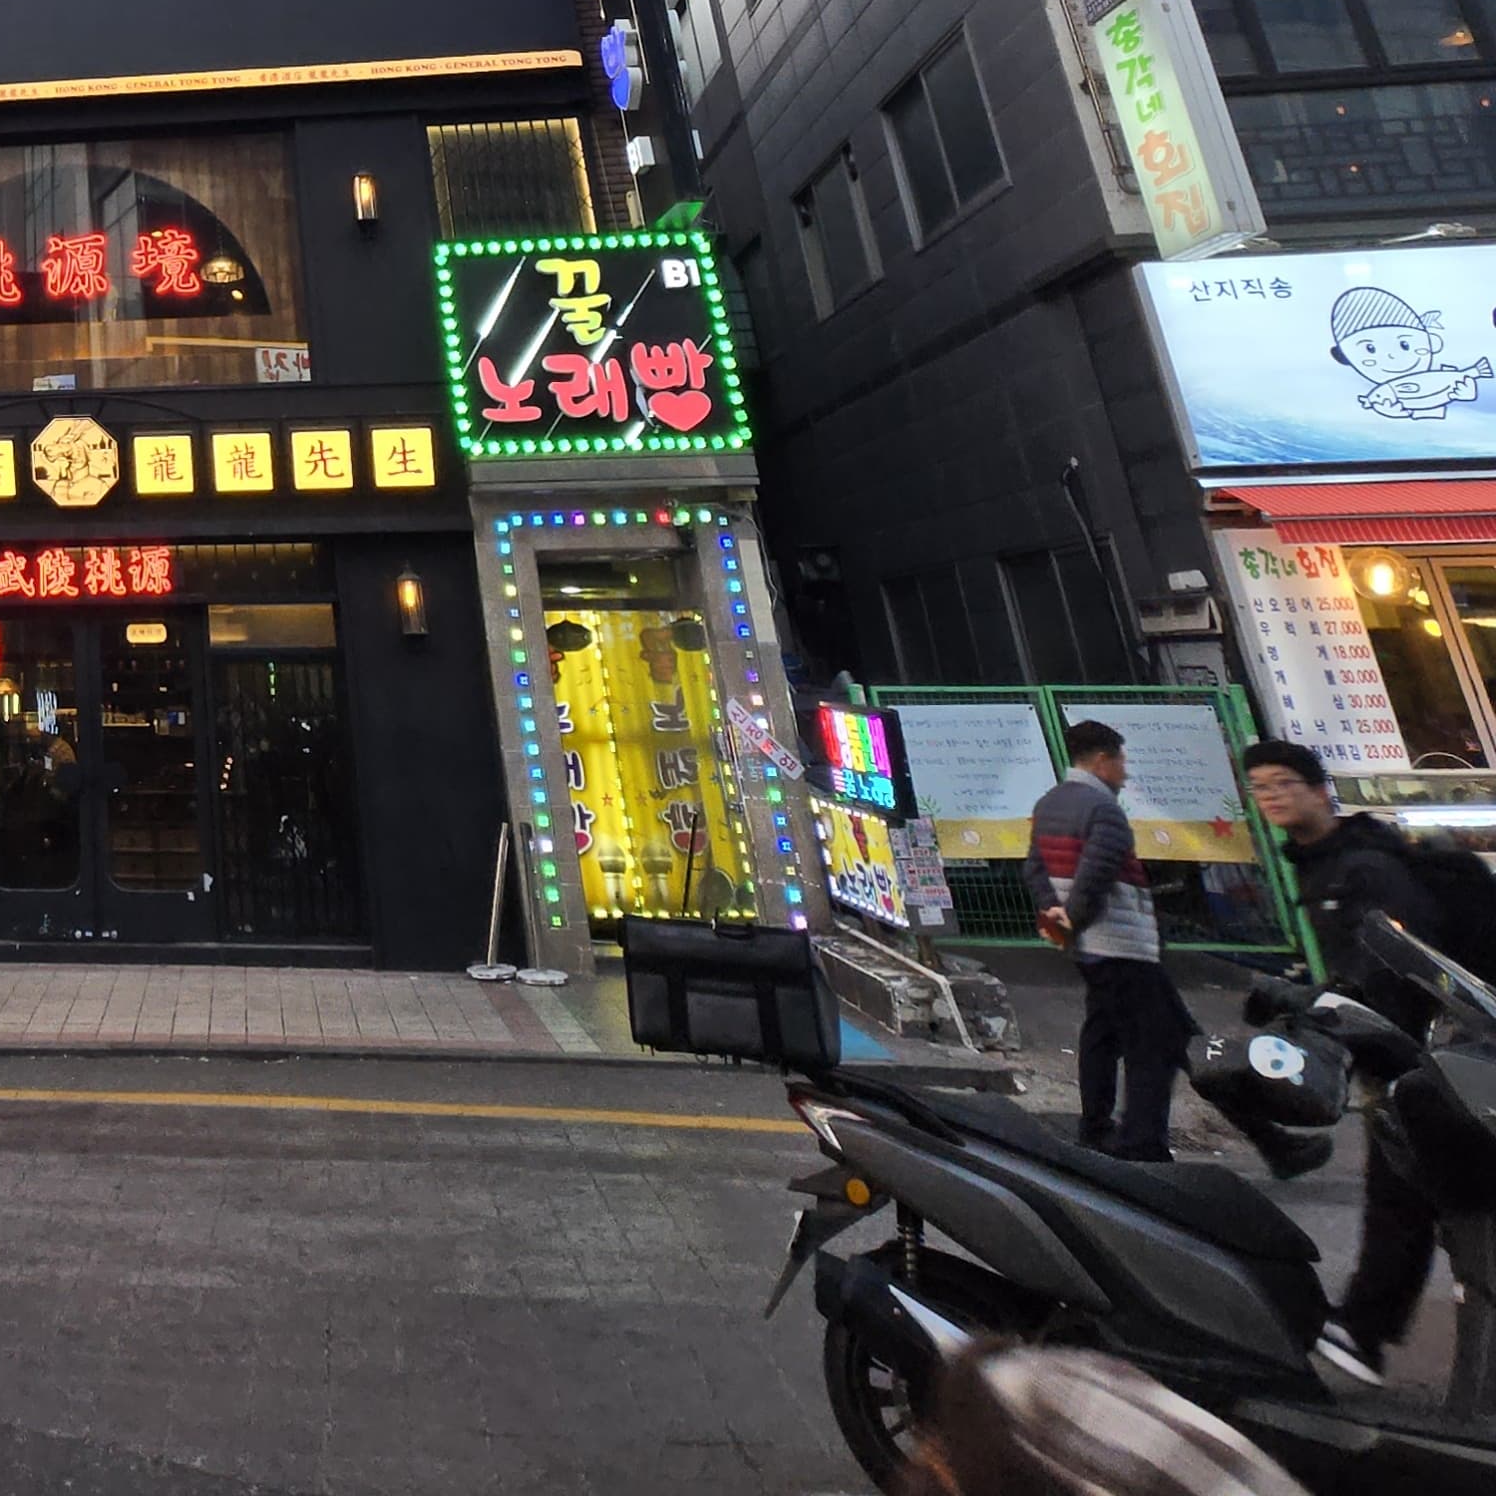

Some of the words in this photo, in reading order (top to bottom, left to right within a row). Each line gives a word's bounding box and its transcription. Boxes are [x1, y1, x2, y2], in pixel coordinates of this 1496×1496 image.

[1106, 8, 1167, 121] 총각네
[1136, 128, 1213, 238] 회집
[661, 258, 702, 289] B1
[1187, 275, 1294, 303] 산지직송
[147, 438, 435, 483] 龍龍先生
[1239, 546, 1297, 581] 총각네
[1296, 545, 1340, 579] 회집
[1318, 596, 1355, 612] 25,000
[1324, 620, 1362, 636] 27,000
[1332, 645, 1371, 660] 18,000
[1339, 670, 1379, 685] 30,000
[1347, 694, 1387, 709] 30,000
[1356, 719, 1395, 734] 25,000
[1364, 744, 1404, 760] 23,000
